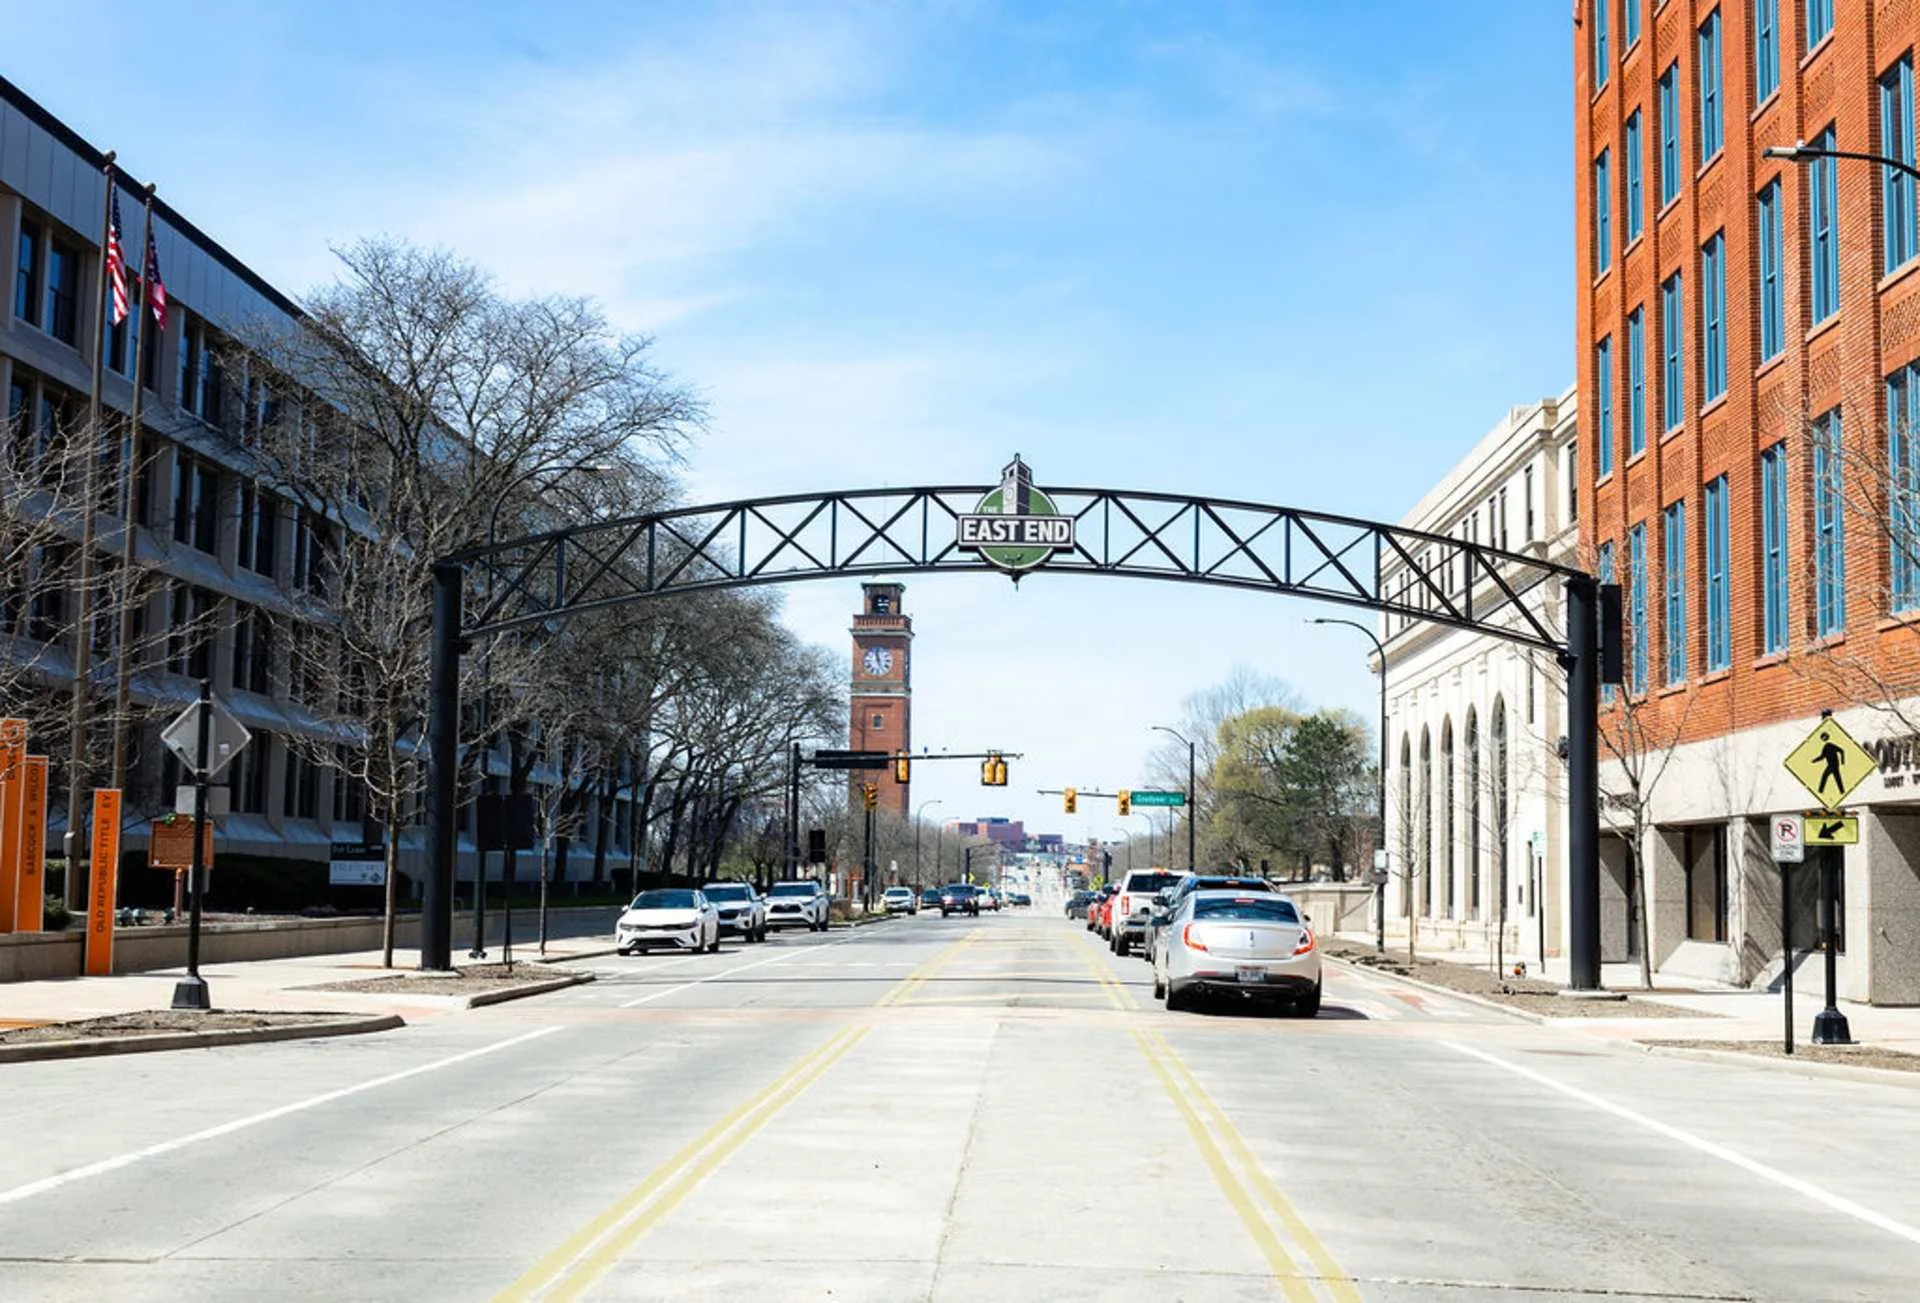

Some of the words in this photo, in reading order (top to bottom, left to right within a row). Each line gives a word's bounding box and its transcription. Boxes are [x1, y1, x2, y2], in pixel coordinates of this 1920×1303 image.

[982, 506, 998, 514] THE
[963, 519, 1019, 541] EAST
[1024, 520, 1070, 542] END
[100, 818, 111, 848] TITLE
[97, 852, 109, 907] REPUBLIC
[95, 910, 105, 933] OLD
